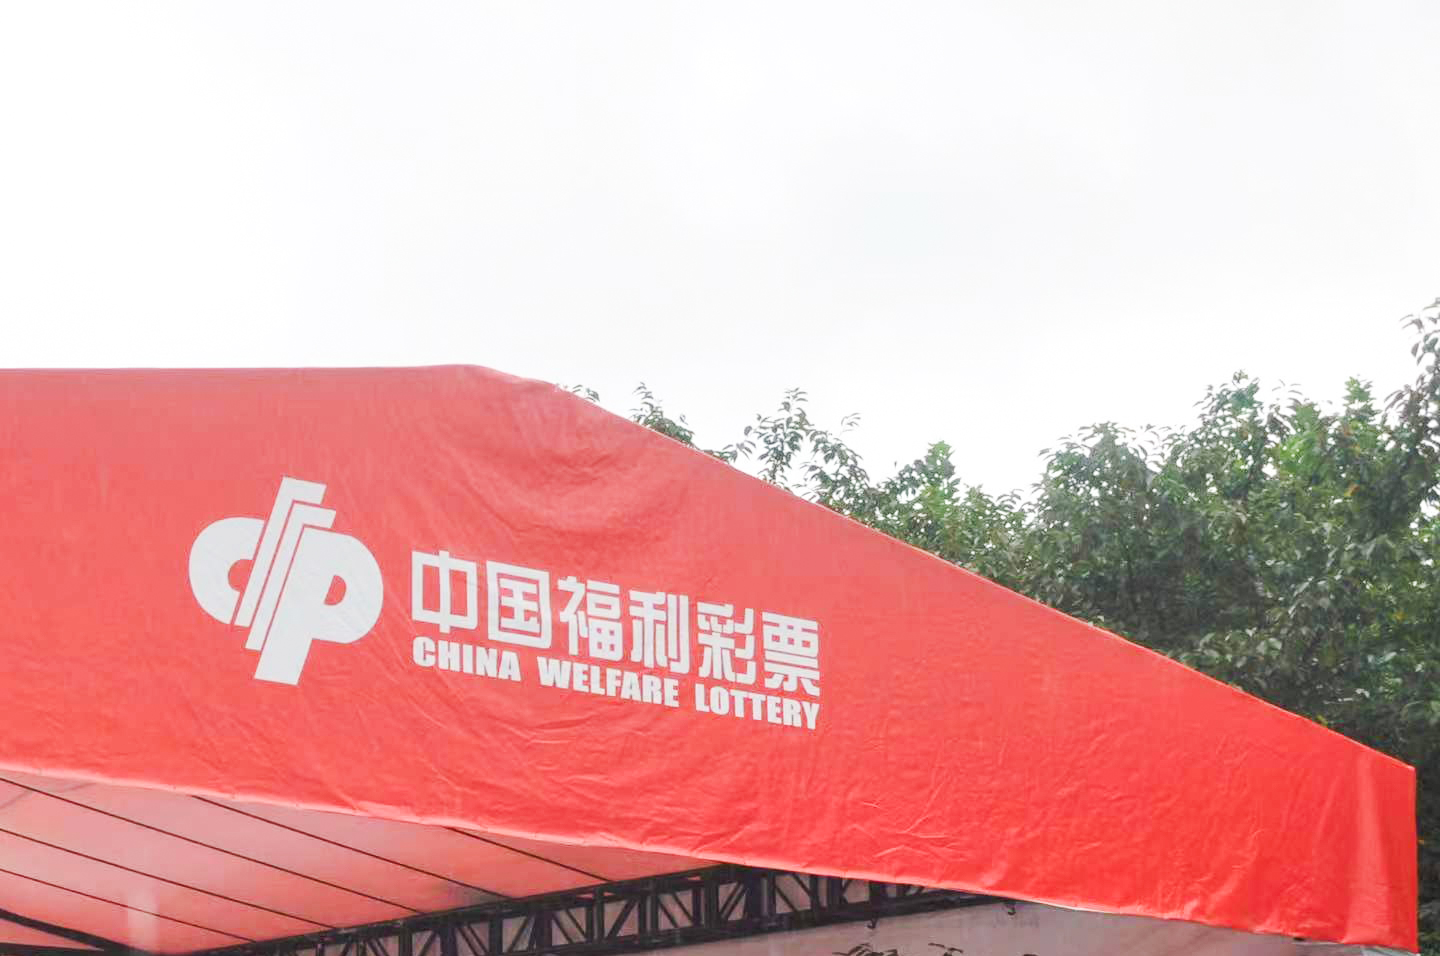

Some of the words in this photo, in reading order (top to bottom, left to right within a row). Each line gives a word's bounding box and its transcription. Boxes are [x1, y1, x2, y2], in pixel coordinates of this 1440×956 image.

[411, 550, 820, 697] 中国福利彩票
[412, 636, 521, 682] CHINA
[536, 656, 679, 708] WELFARE
[695, 684, 820, 730] LOTTERY
